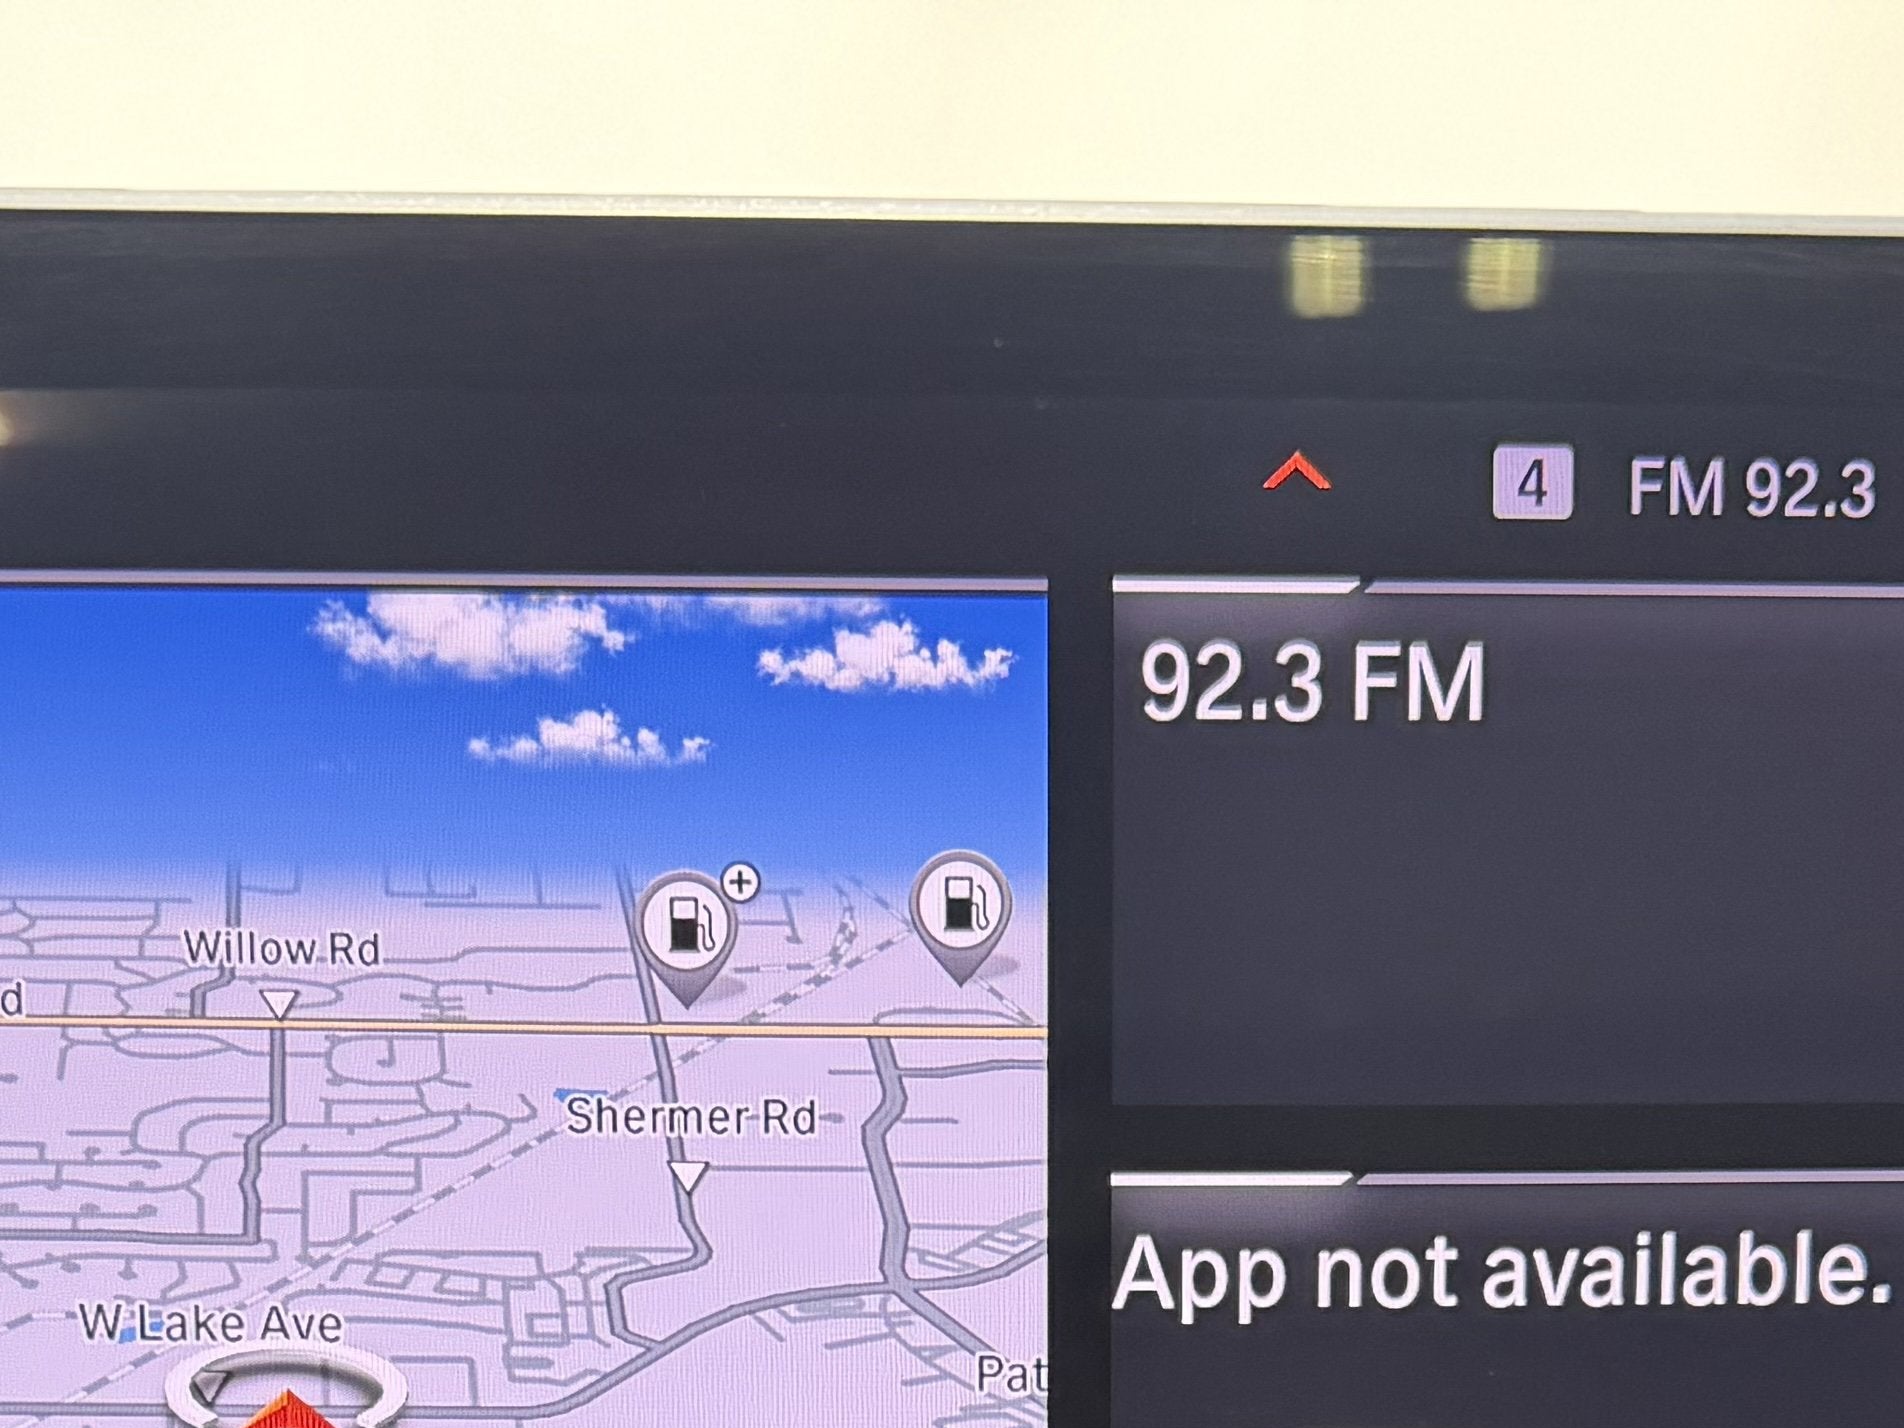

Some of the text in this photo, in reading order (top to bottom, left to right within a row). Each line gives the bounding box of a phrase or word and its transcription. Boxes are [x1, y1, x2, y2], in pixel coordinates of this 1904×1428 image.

[1517, 459, 1547, 507] 4
[1631, 457, 1877, 517] FM 92.3
[1143, 640, 1484, 722] 92.3 FM
[183, 928, 380, 966] Willow Rd
[566, 1098, 816, 1135] Shermer Rd
[1112, 1229, 1891, 1325] App not available.
[79, 1302, 343, 1341] W Lake Ave
[979, 1355, 1048, 1392] Pat
